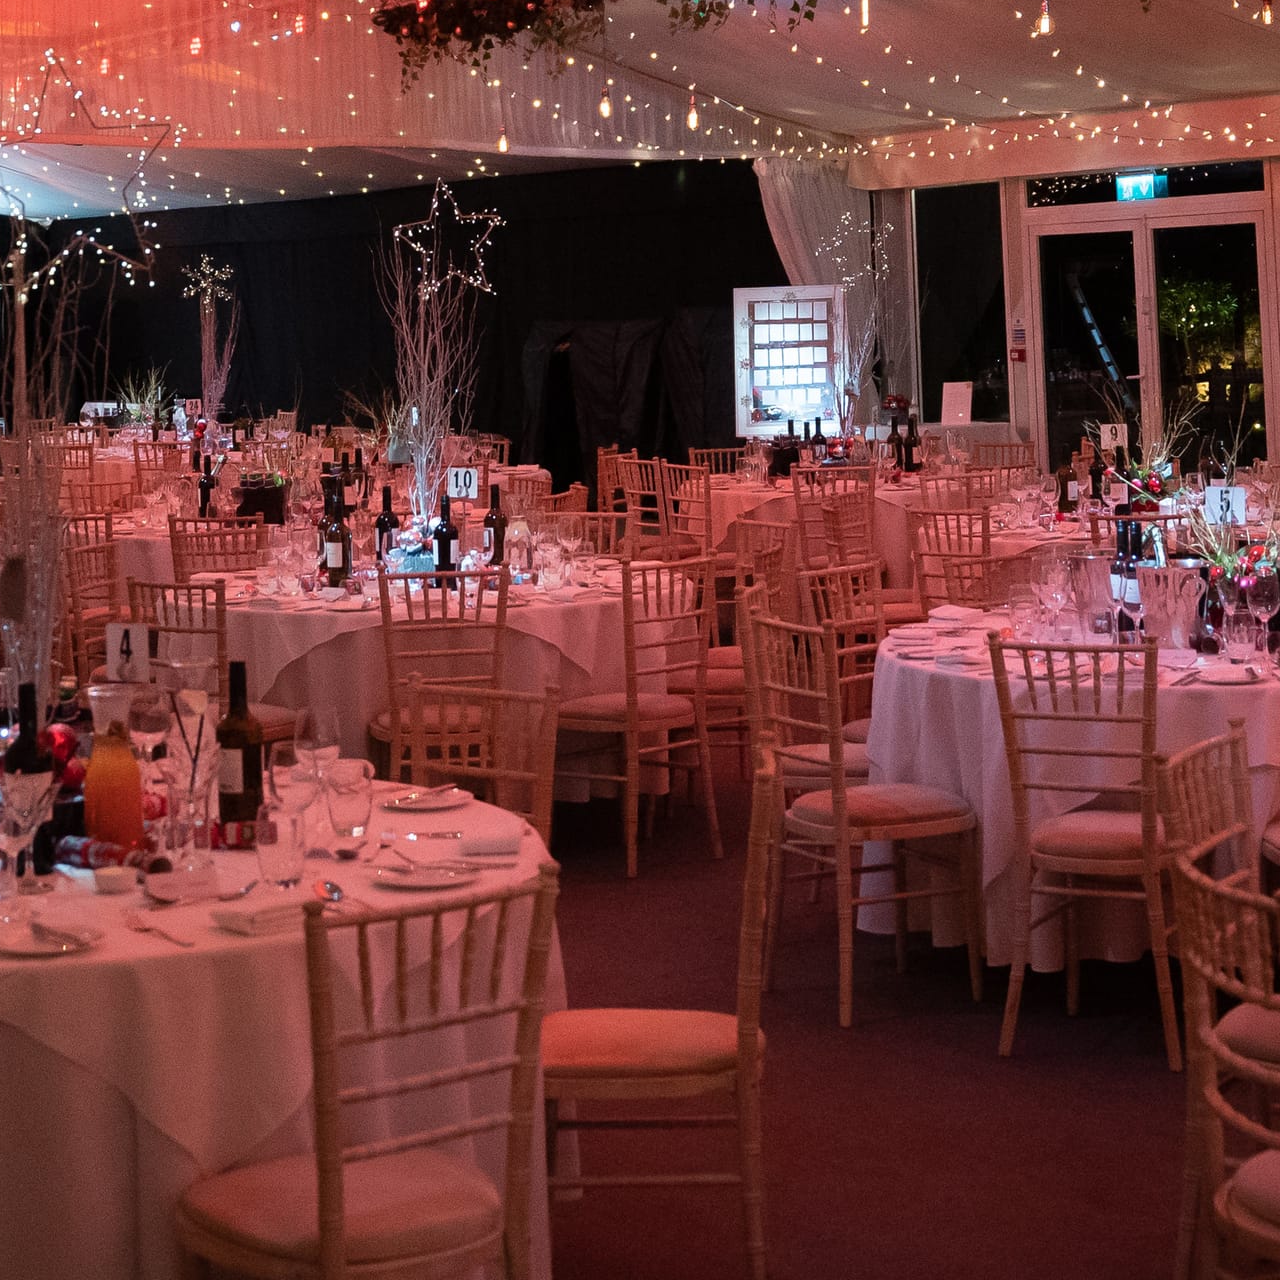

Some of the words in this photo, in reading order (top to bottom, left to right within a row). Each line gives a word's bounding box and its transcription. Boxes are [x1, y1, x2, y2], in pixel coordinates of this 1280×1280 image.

[1110, 425, 1118, 441] 9
[454, 470, 472, 489] 10
[1220, 489, 1230, 513] 5
[119, 628, 133, 663] 4
